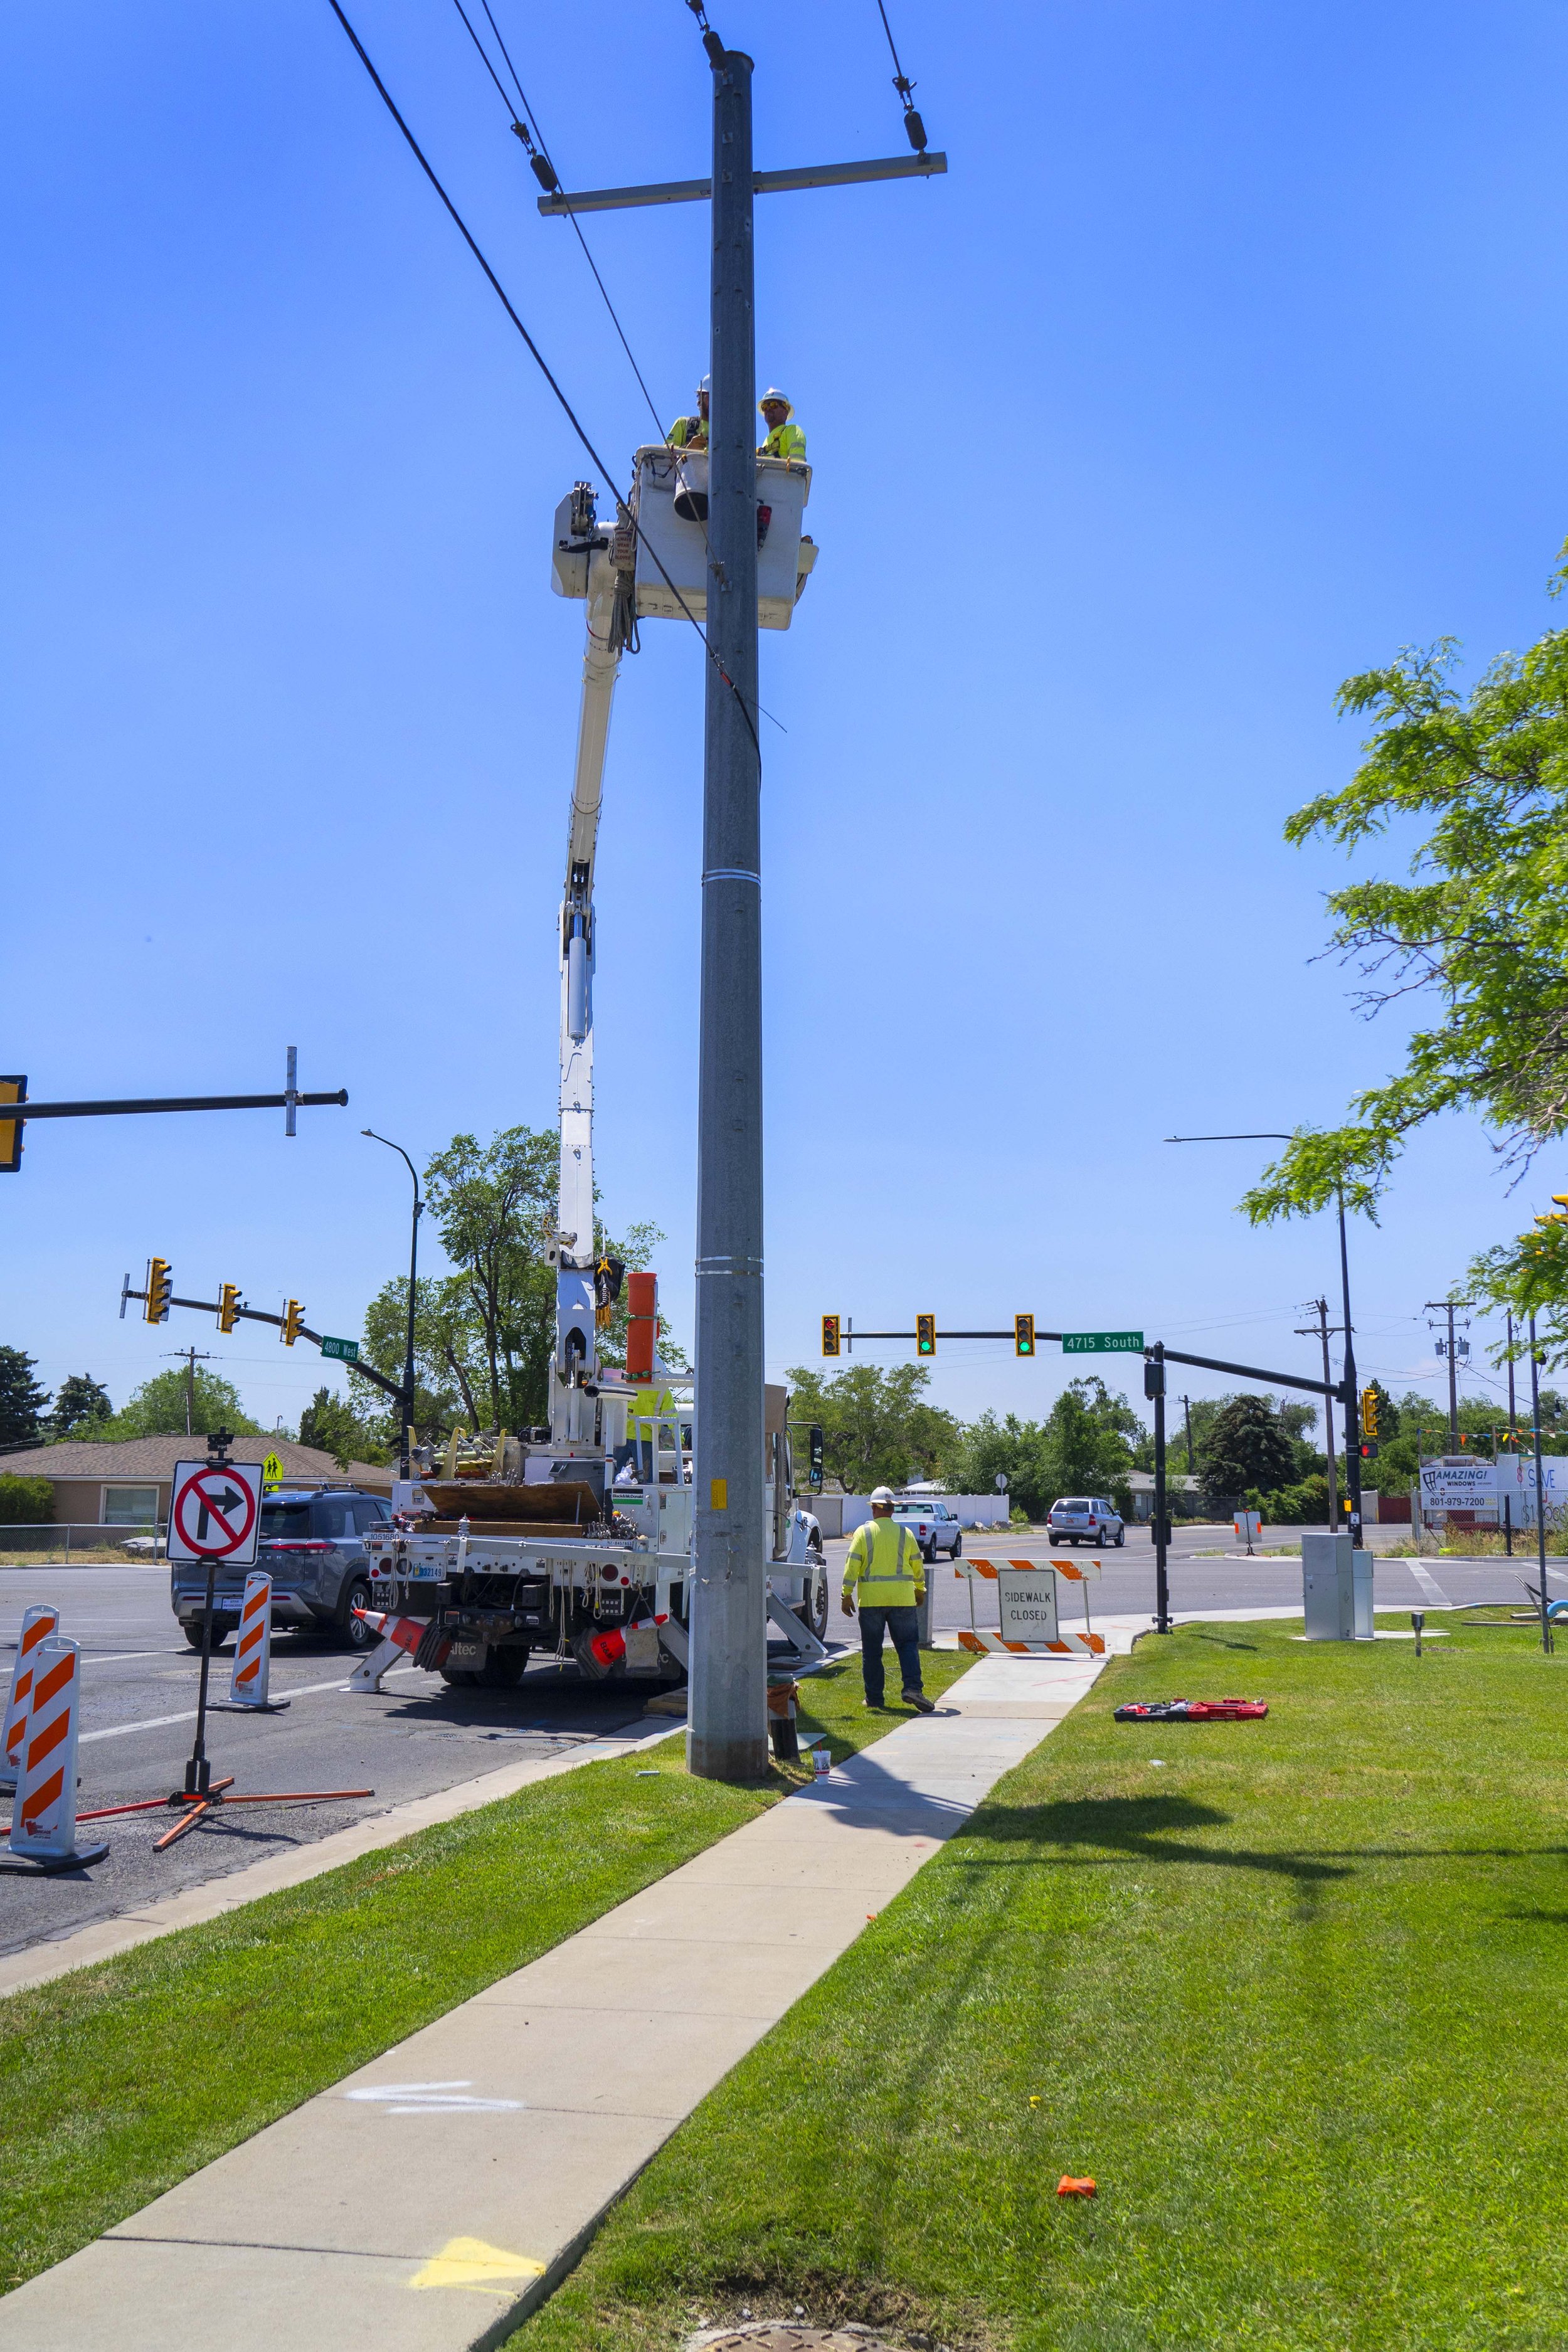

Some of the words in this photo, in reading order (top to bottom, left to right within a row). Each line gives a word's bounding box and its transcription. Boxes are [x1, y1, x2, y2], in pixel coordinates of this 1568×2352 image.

[1067, 1337, 1095, 1349] 4715
[1104, 1336, 1140, 1348] South
[324, 1341, 340, 1355] 4800
[343, 1344, 356, 1358] West
[1435, 1470, 1488, 1480] AMAZING!
[1430, 1497, 1485, 1506] 801-979-7200
[1005, 1592, 1051, 1603] SIDEWALK
[1010, 1610, 1047, 1621] CLOSED
